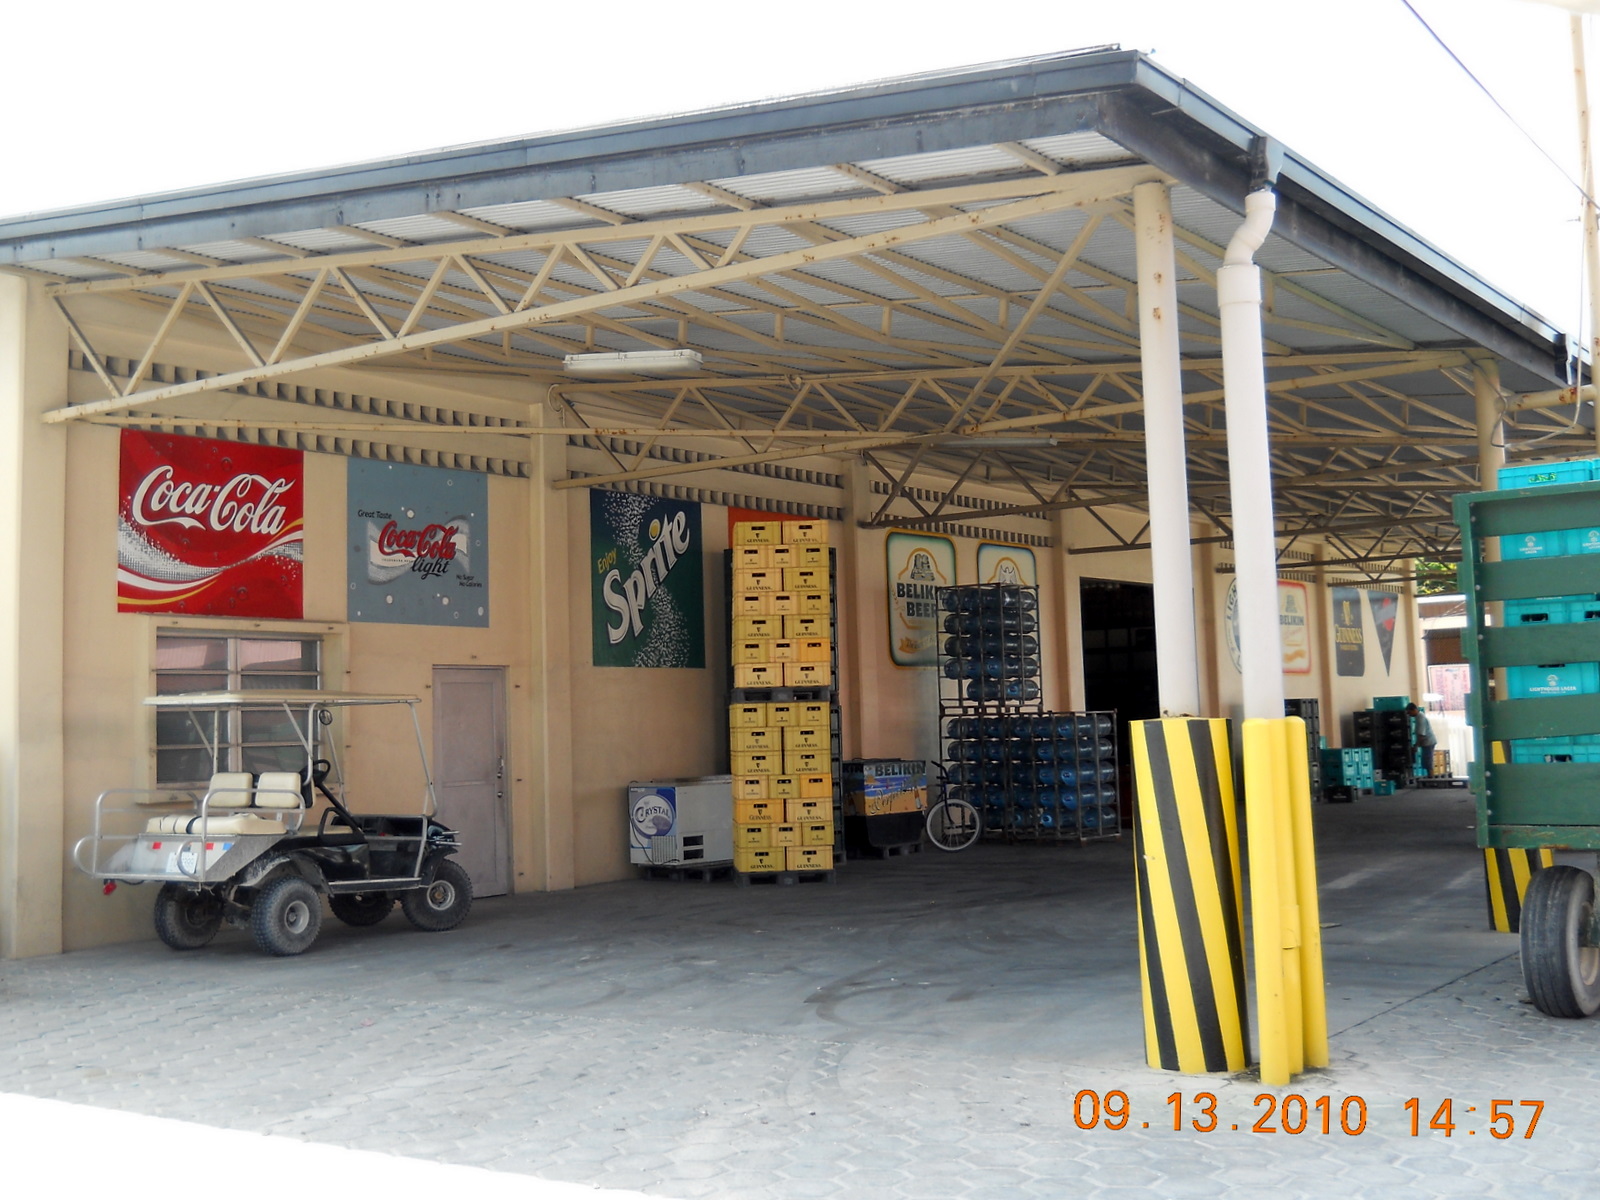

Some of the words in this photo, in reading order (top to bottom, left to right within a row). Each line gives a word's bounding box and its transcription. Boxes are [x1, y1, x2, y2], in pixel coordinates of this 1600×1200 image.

[132, 465, 296, 535] Coca-Cola
[358, 509, 375, 518] Great
[376, 510, 392, 519] Taste
[378, 520, 459, 560] Coca-Cola
[411, 556, 450, 580] light
[597, 548, 617, 574] Enjoy
[603, 510, 690, 644] Sprite
[906, 601, 938, 618] BEER
[874, 762, 926, 776] BELIKIN
[634, 805, 671, 823] CRYSTAL
